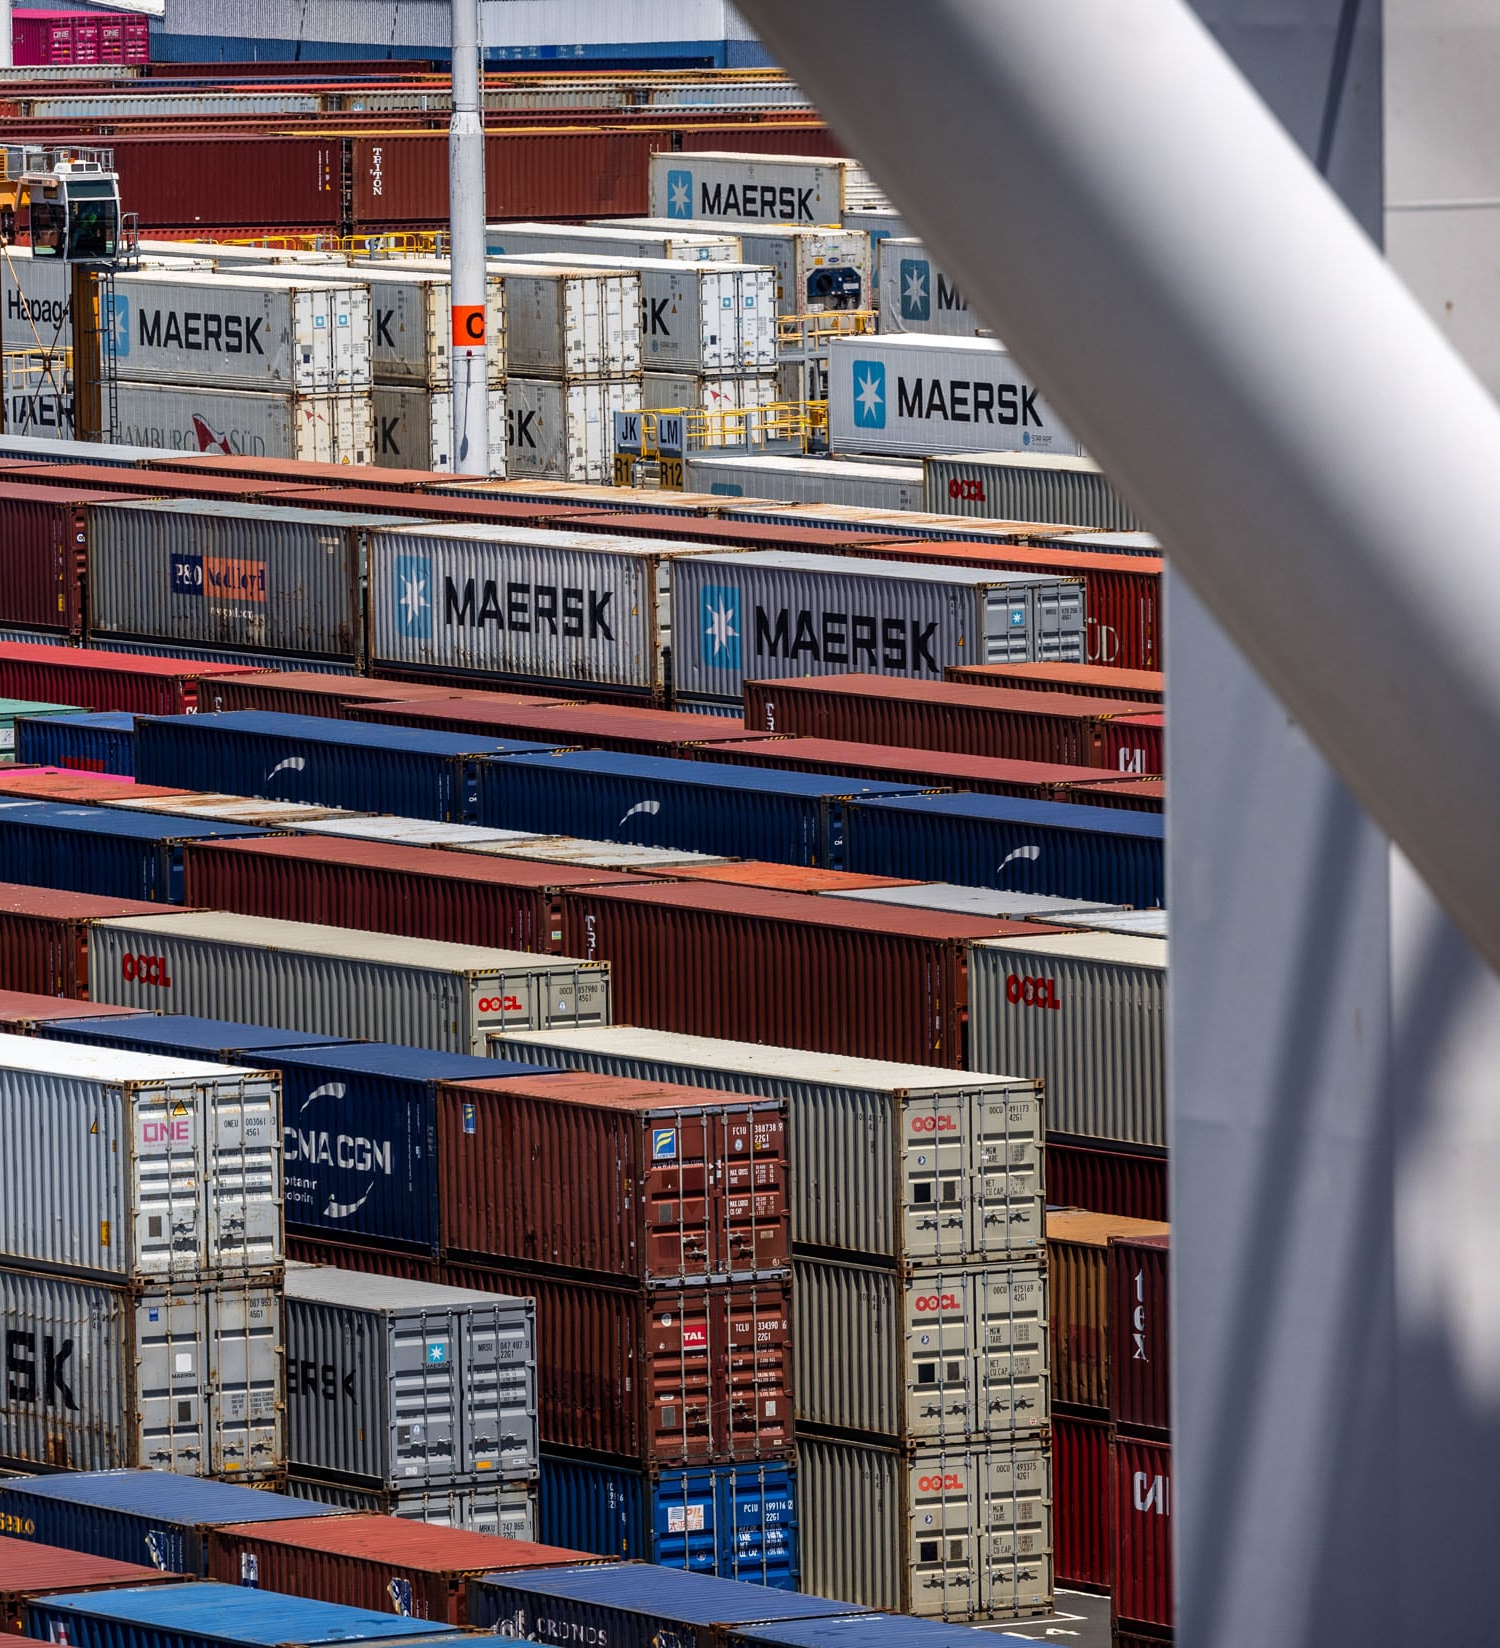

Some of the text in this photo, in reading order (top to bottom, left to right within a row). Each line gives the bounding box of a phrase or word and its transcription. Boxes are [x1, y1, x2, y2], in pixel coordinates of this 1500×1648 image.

[372, 147, 383, 196] TRITON
[701, 182, 816, 221] MAERSK
[139, 309, 264, 355] MAERSK
[898, 376, 1043, 428] MAERSK
[622, 416, 638, 441] JK
[660, 417, 678, 445] LM
[445, 576, 615, 642] MAERSK
[756, 605, 940, 673] MAERSK
[122, 953, 171, 988] OOCL
[1006, 973, 1060, 1010] OOCL
[478, 996, 522, 1012] OOCL
[143, 1121, 189, 1142] ONE
[223, 1119, 239, 1128] ONEU
[245, 1117, 266, 1126] 003061
[754, 1123, 777, 1132] 388738
[778, 1122, 783, 1131] 9
[912, 1115, 957, 1132] OOCL
[754, 1134, 769, 1143] 22G1
[337, 1133, 392, 1175] CGM
[915, 1294, 960, 1312] OOCL
[1133, 1268, 1148, 1361] tex
[683, 1331, 705, 1341] TAL
[735, 1320, 787, 1332] TCLU 334390 6
[757, 1332, 771, 1341] 22G1
[1016, 1462, 1037, 1471] 493375
[918, 1474, 963, 1491] OOCL
[765, 1502, 786, 1511] 199116
